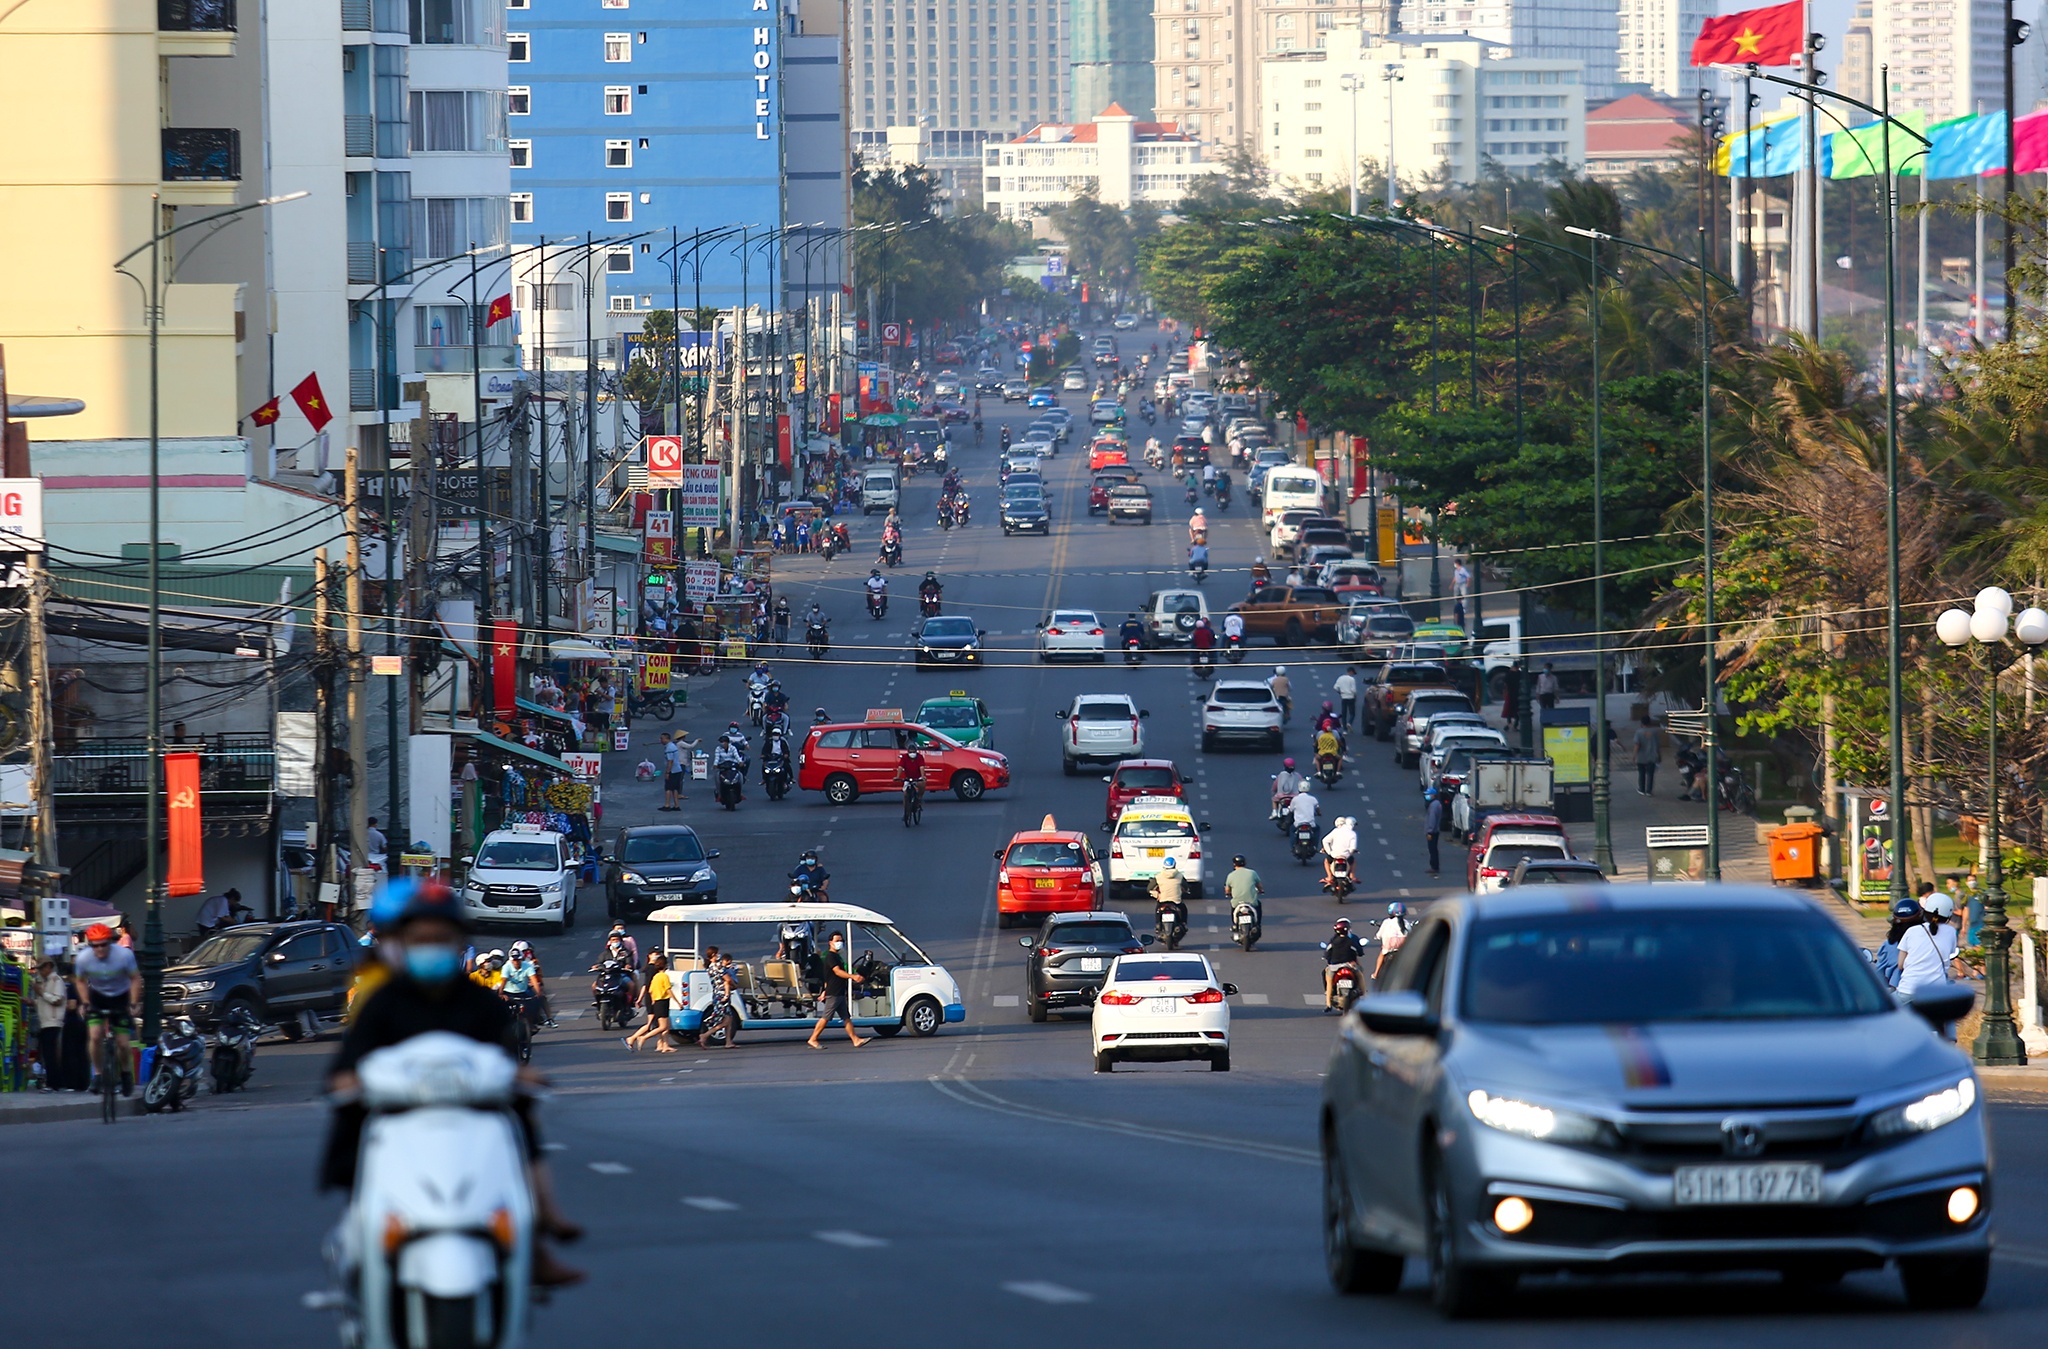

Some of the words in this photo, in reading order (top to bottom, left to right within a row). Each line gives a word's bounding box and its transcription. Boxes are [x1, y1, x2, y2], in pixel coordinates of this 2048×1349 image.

[753, 27, 771, 140] HOTEL
[659, 446, 677, 462] K
[437, 476, 485, 489] HOTE
[0, 493, 22, 516] G
[651, 519, 669, 532] 41
[702, 577, 716, 586] 250
[1868, 814, 1890, 822] pepsi
